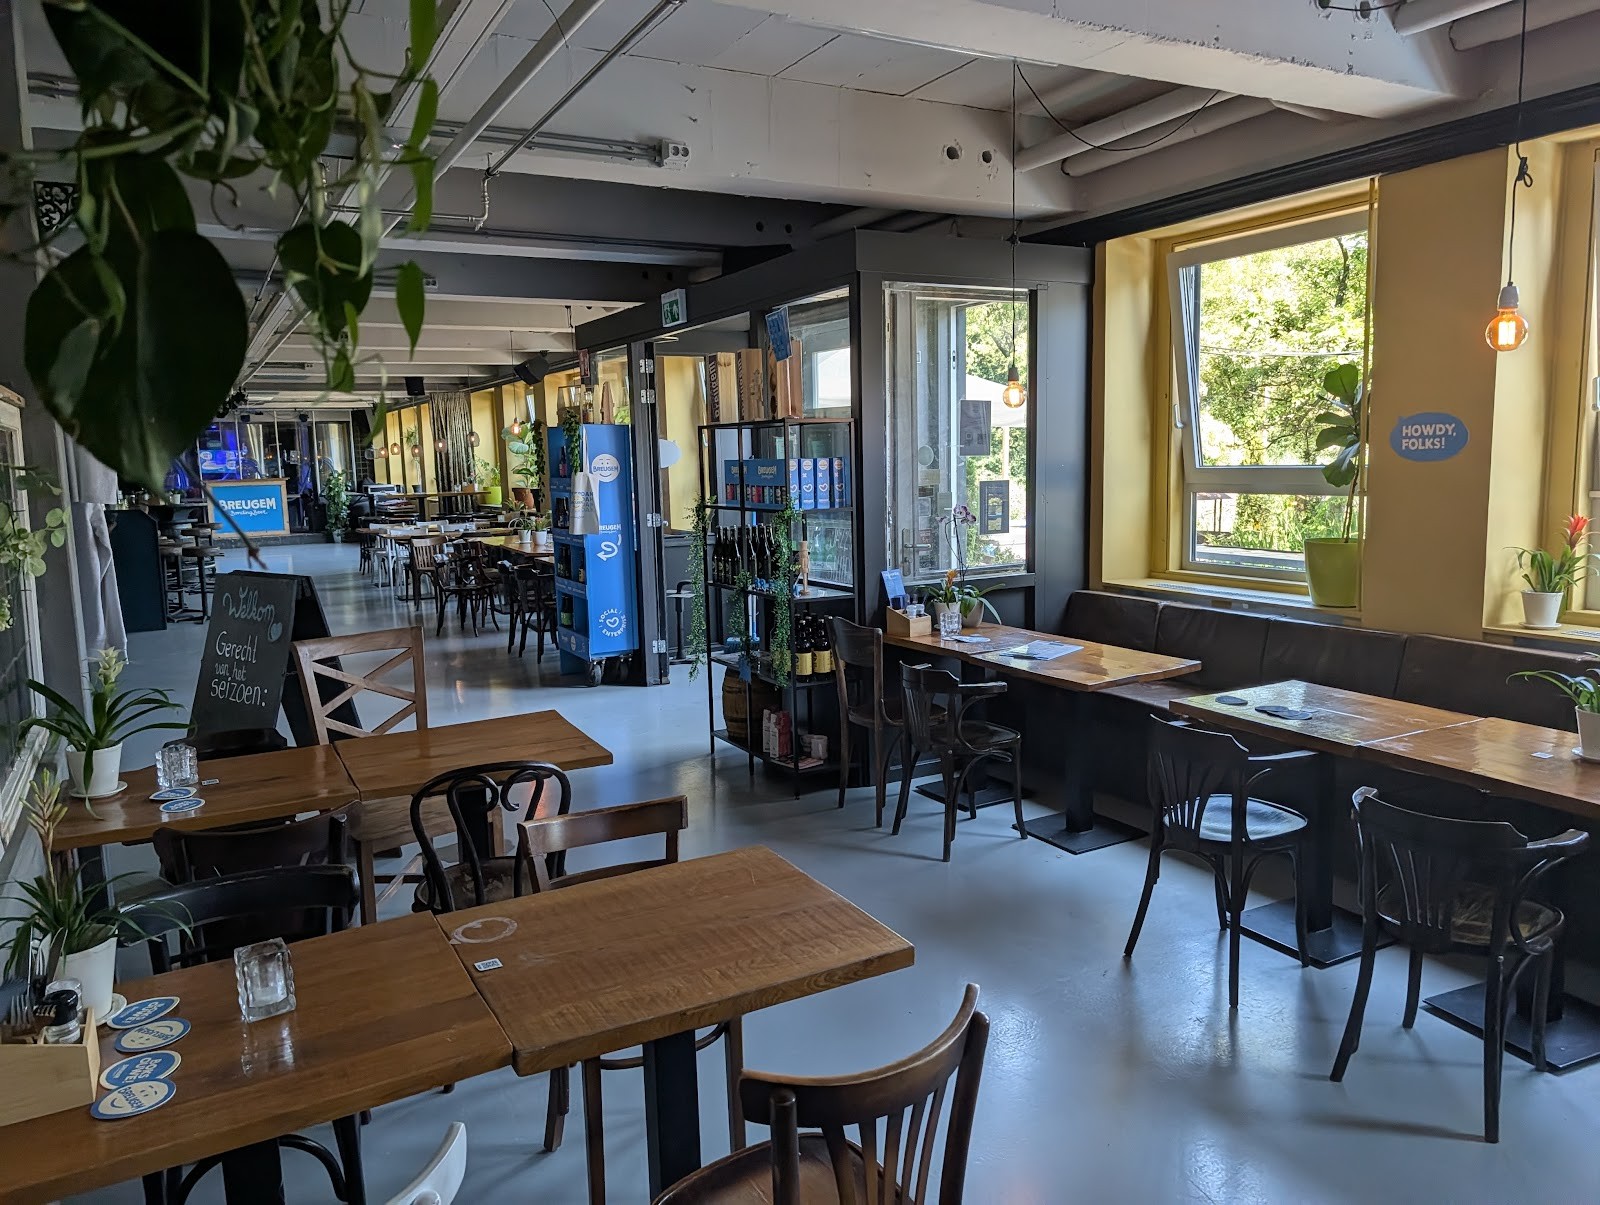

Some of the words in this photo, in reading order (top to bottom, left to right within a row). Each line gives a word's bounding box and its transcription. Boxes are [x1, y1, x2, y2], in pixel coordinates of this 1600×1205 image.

[1402, 423, 1457, 437] HOWDY,
[1401, 437, 1446, 450] FOLKS!
[593, 465, 619, 473] BREUGEM
[219, 497, 277, 511] BREUGEM
[599, 523, 622, 531] REUGEM
[222, 586, 275, 624] Welkom
[599, 608, 618, 623] SOCIAL
[602, 614, 627, 637] ENTERPRISE
[215, 630, 258, 663] Gerecht
[215, 662, 229, 676] van
[232, 661, 247, 680] het
[134, 1027, 175, 1041] BREUGEM
[138, 1058, 163, 1079] BOKS
[118, 1086, 148, 1111] BREUGEM
